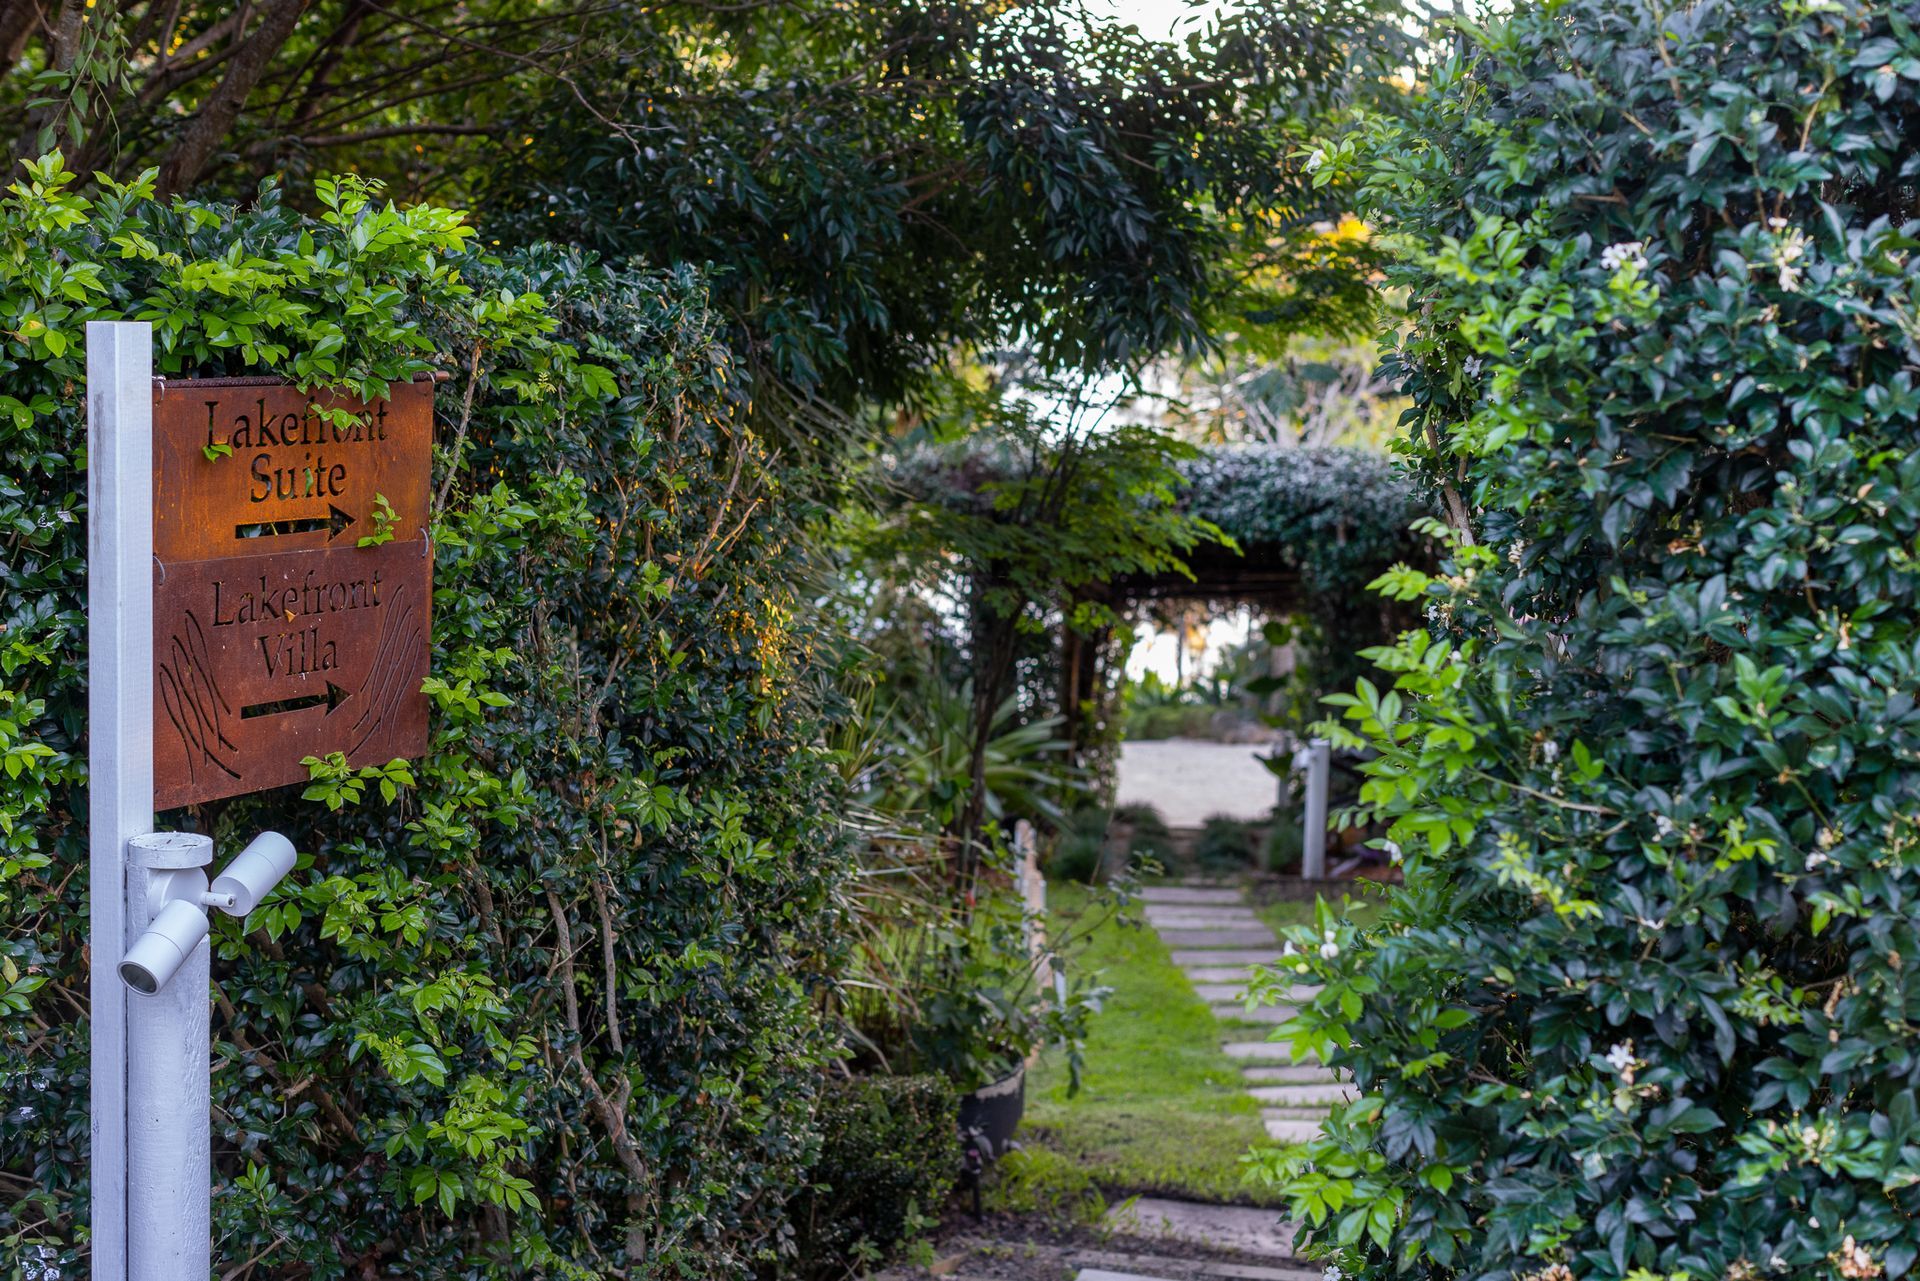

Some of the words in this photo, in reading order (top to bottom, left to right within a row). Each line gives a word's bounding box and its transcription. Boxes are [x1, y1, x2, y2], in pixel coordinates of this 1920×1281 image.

[250, 452, 346, 503] Suite
[212, 570, 383, 627] Lakefront
[257, 628, 340, 679] Villa
